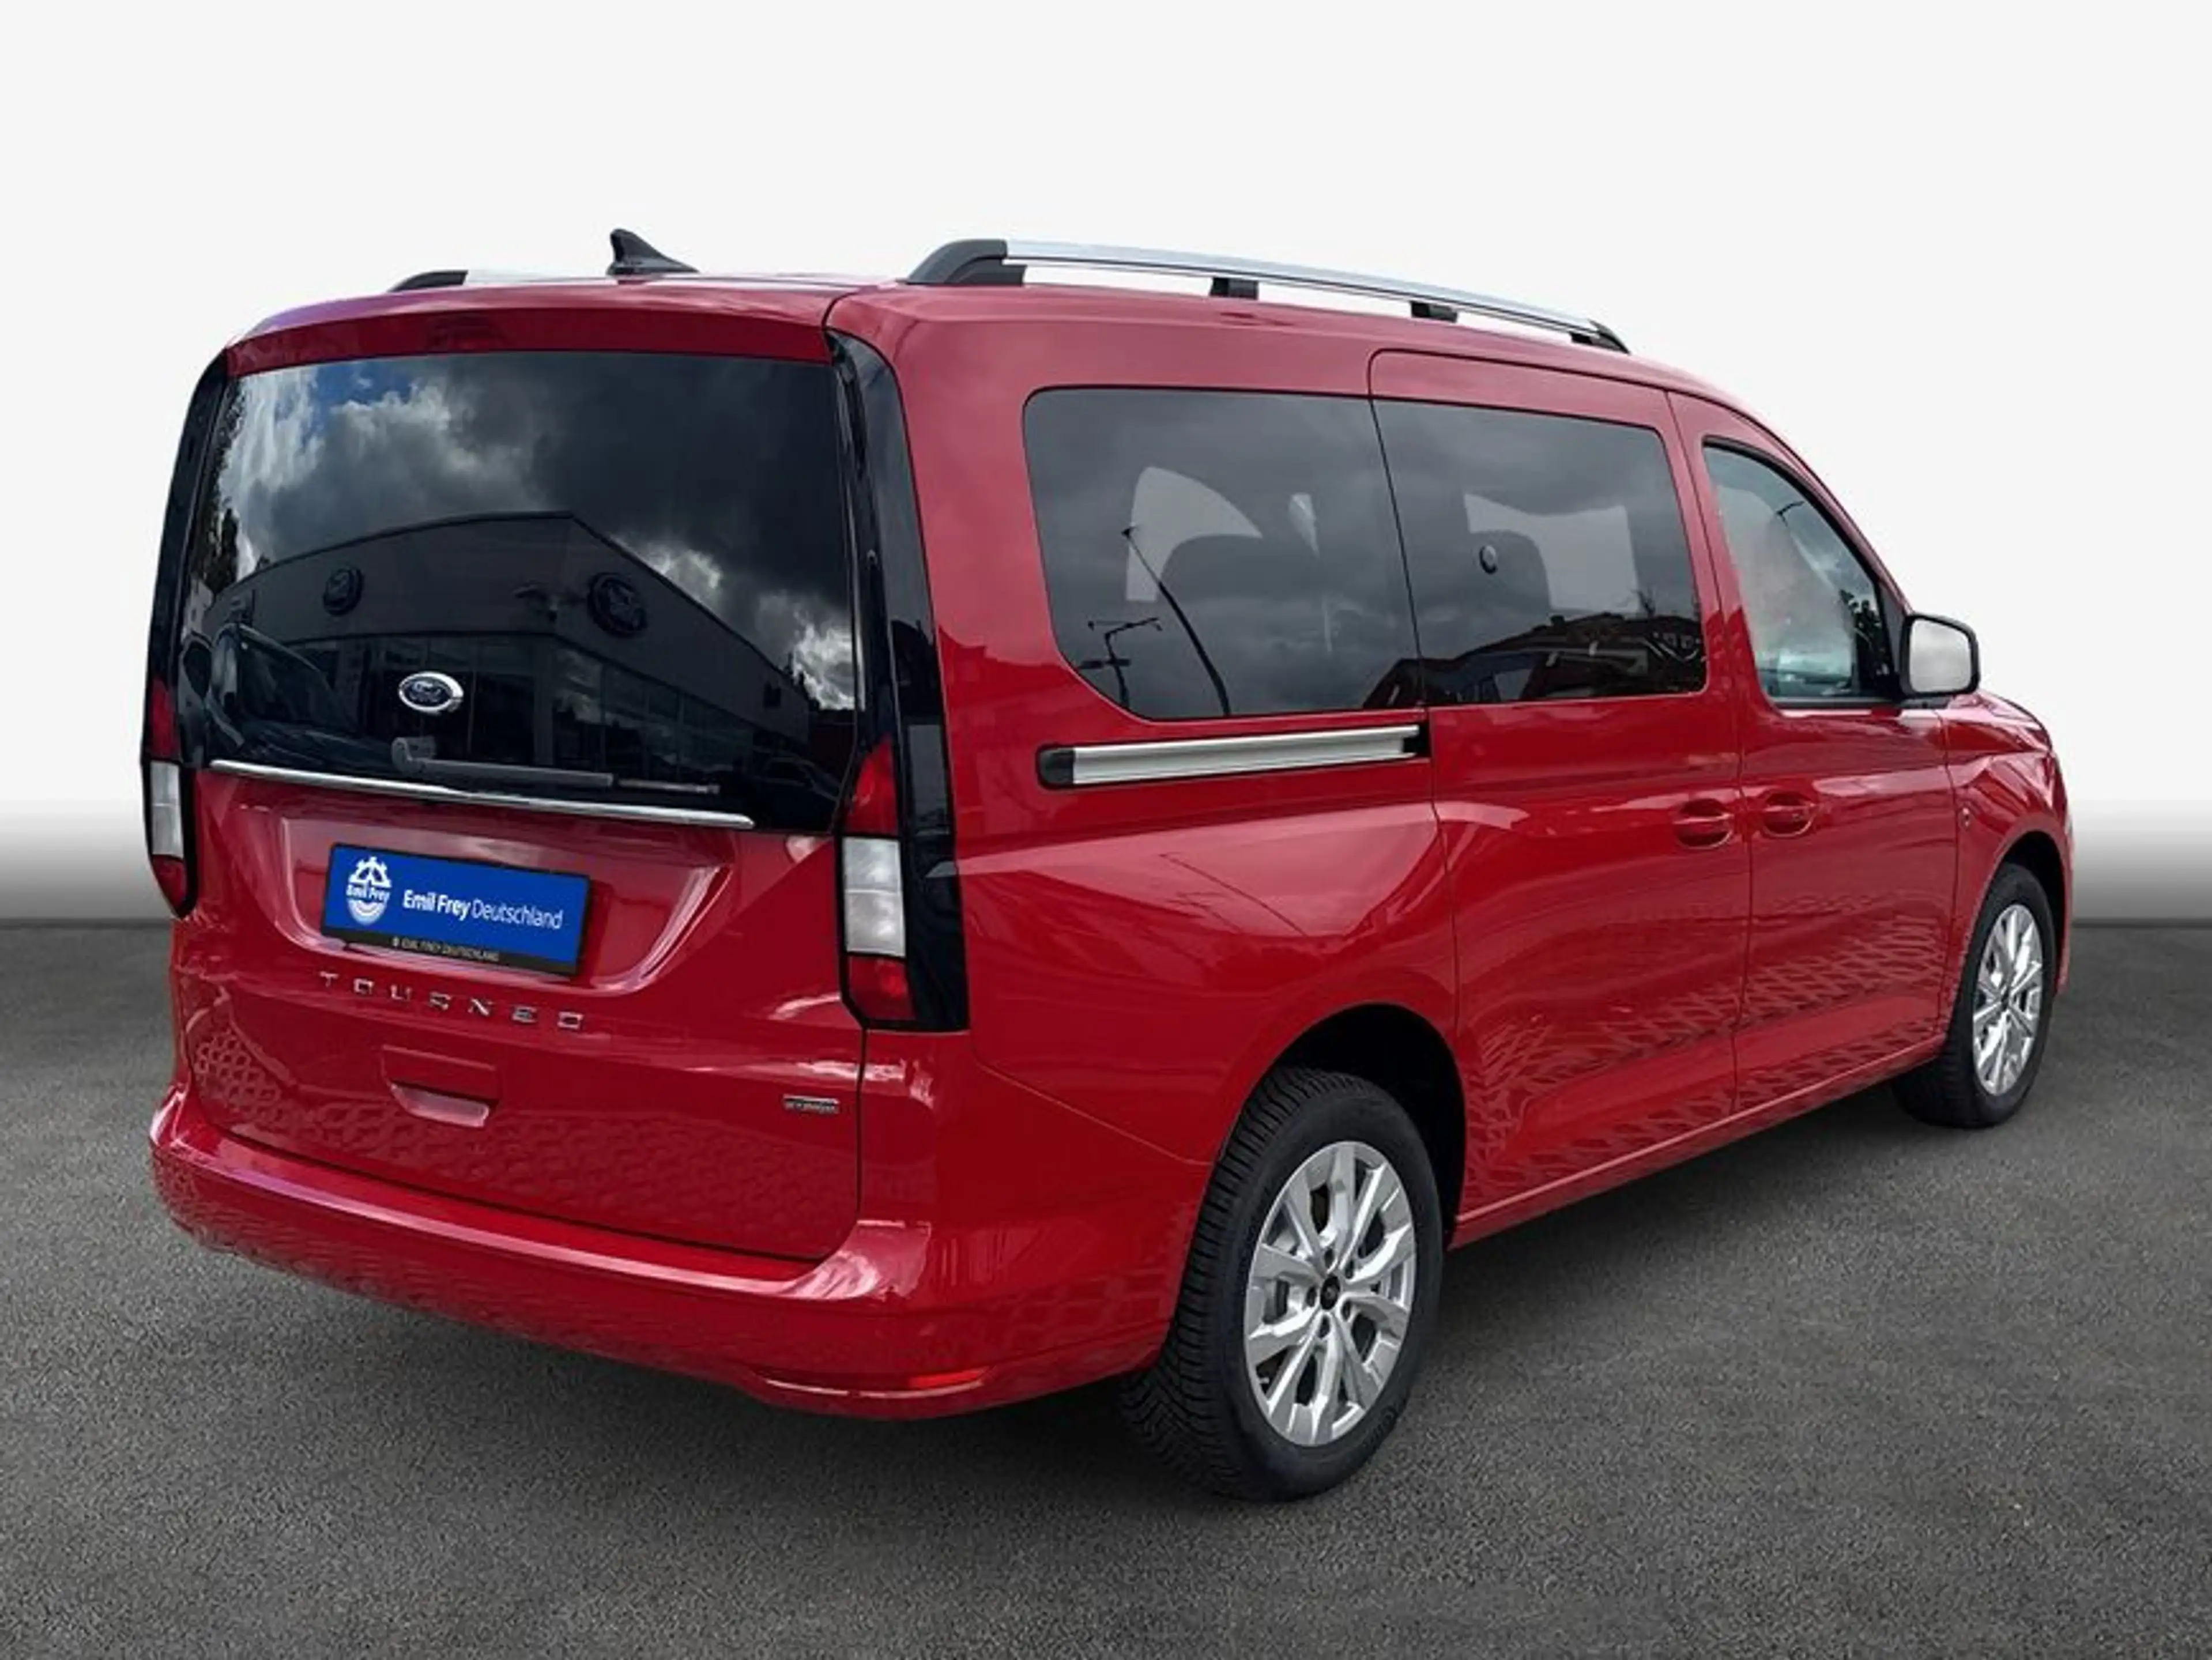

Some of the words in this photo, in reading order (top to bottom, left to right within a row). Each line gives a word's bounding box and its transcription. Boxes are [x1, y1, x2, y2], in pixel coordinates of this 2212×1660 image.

[402, 889, 435, 911] Emil
[436, 894, 471, 921] Frey
[471, 898, 564, 930] Deutschland
[319, 971, 584, 1029] TOURNEO
